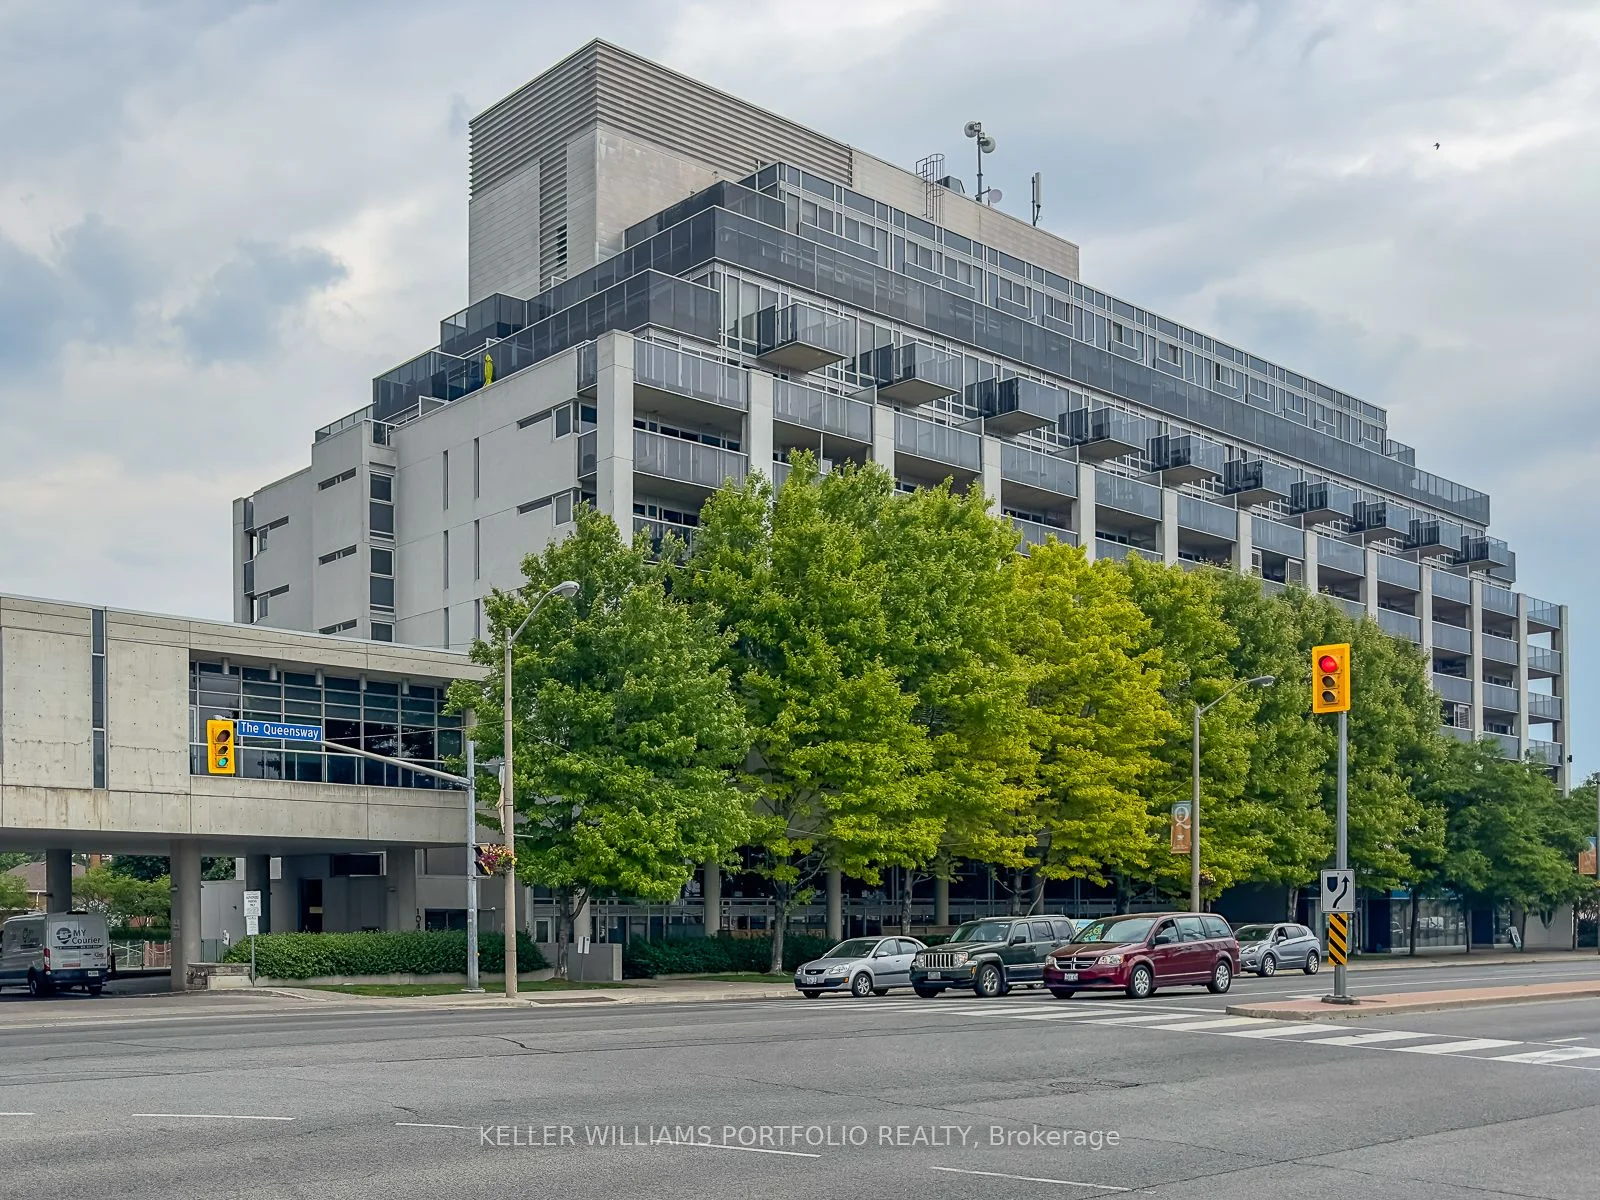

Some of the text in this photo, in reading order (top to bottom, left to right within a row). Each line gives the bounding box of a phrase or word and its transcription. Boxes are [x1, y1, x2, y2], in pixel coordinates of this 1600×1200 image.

[240, 721, 319, 741] The Queensway
[73, 929, 87, 937] MY
[71, 937, 101, 945] Courier
